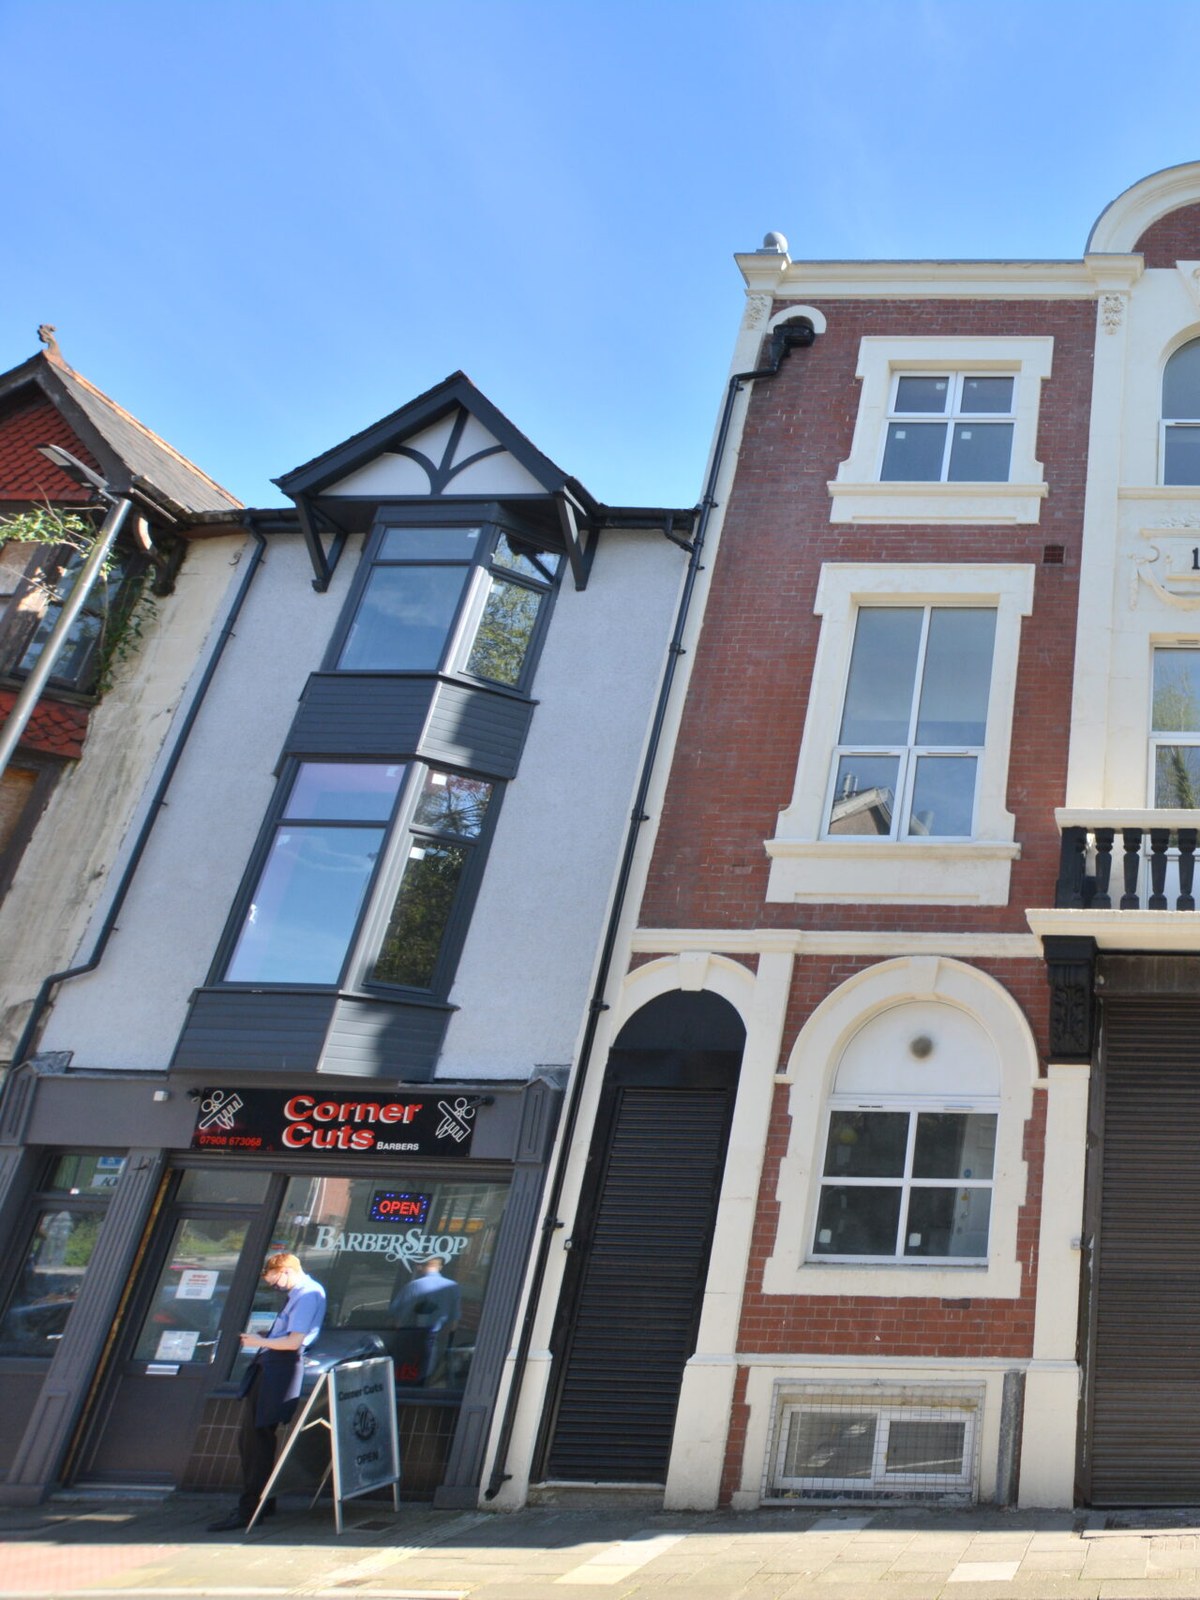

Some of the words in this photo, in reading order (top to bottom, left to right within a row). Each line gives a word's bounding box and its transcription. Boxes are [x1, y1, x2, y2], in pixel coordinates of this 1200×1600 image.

[284, 1095, 423, 1123] Corner
[282, 1122, 375, 1149] Cuts
[376, 1141, 419, 1151] BARBERS
[379, 1200, 420, 1215] OPEN
[363, 1383, 384, 1396] Cuts
[356, 1451, 379, 1465] OPEN
